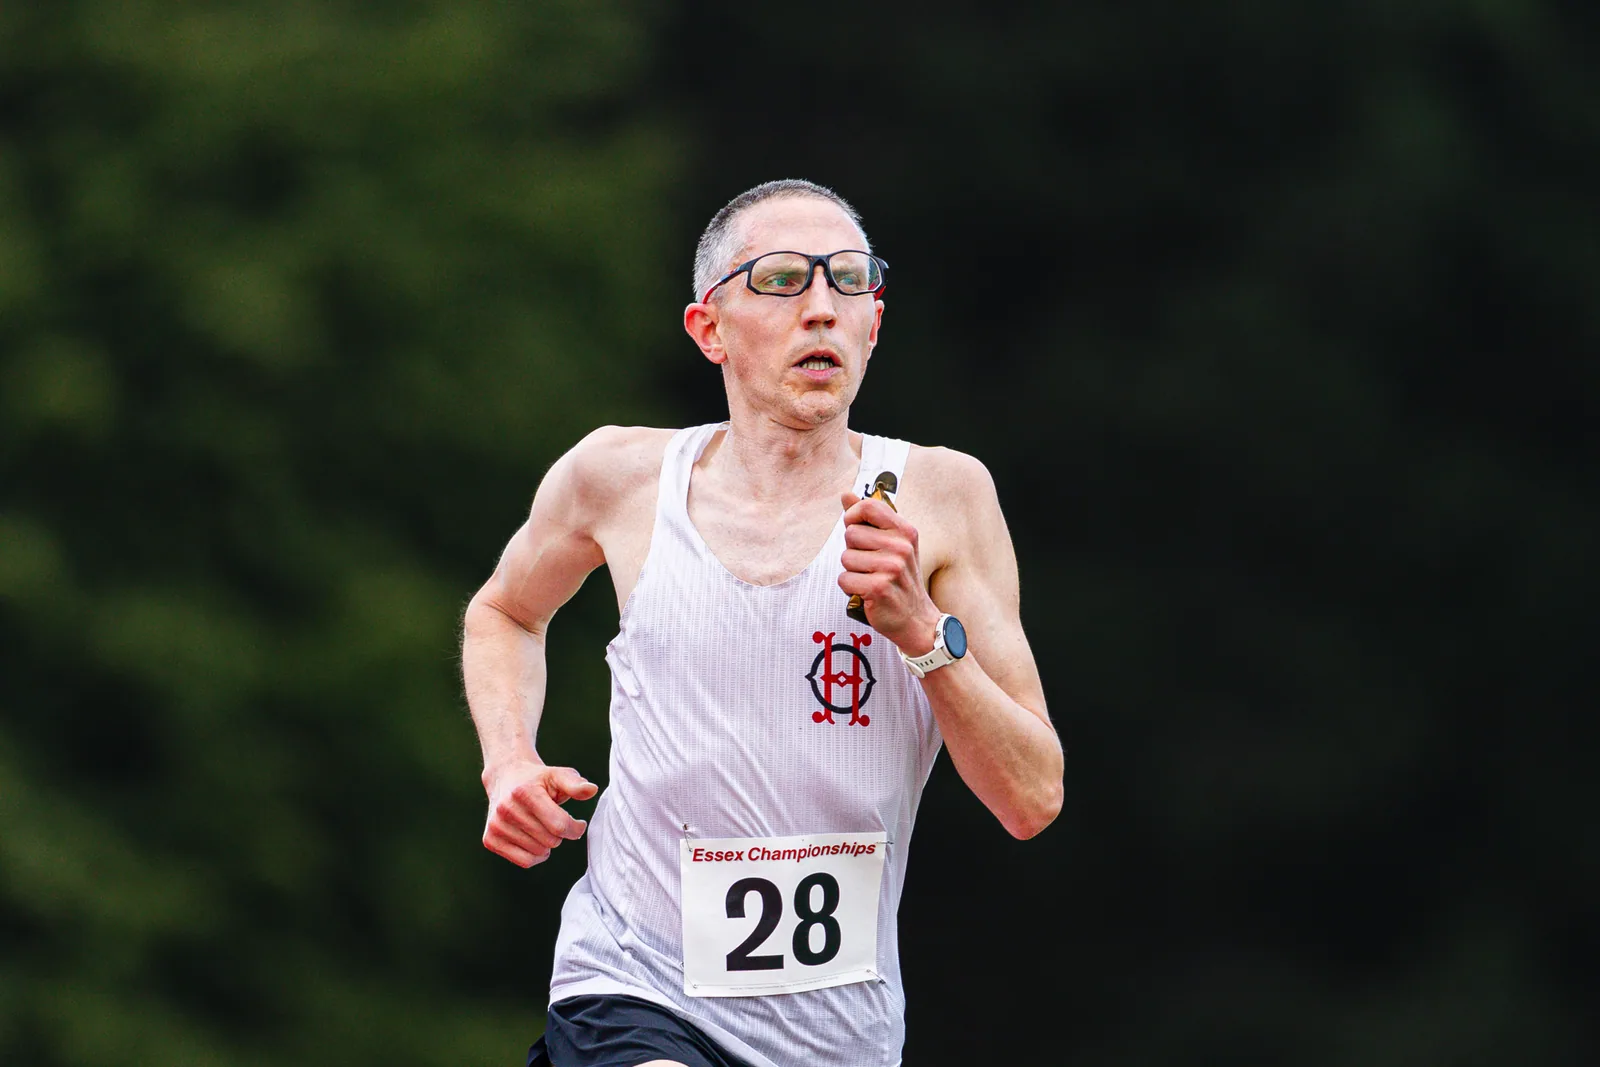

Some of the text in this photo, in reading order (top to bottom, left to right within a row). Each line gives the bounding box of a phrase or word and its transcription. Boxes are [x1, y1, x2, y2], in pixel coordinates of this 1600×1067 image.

[692, 841, 876, 863] Essex Championships
[725, 872, 841, 972] 28
